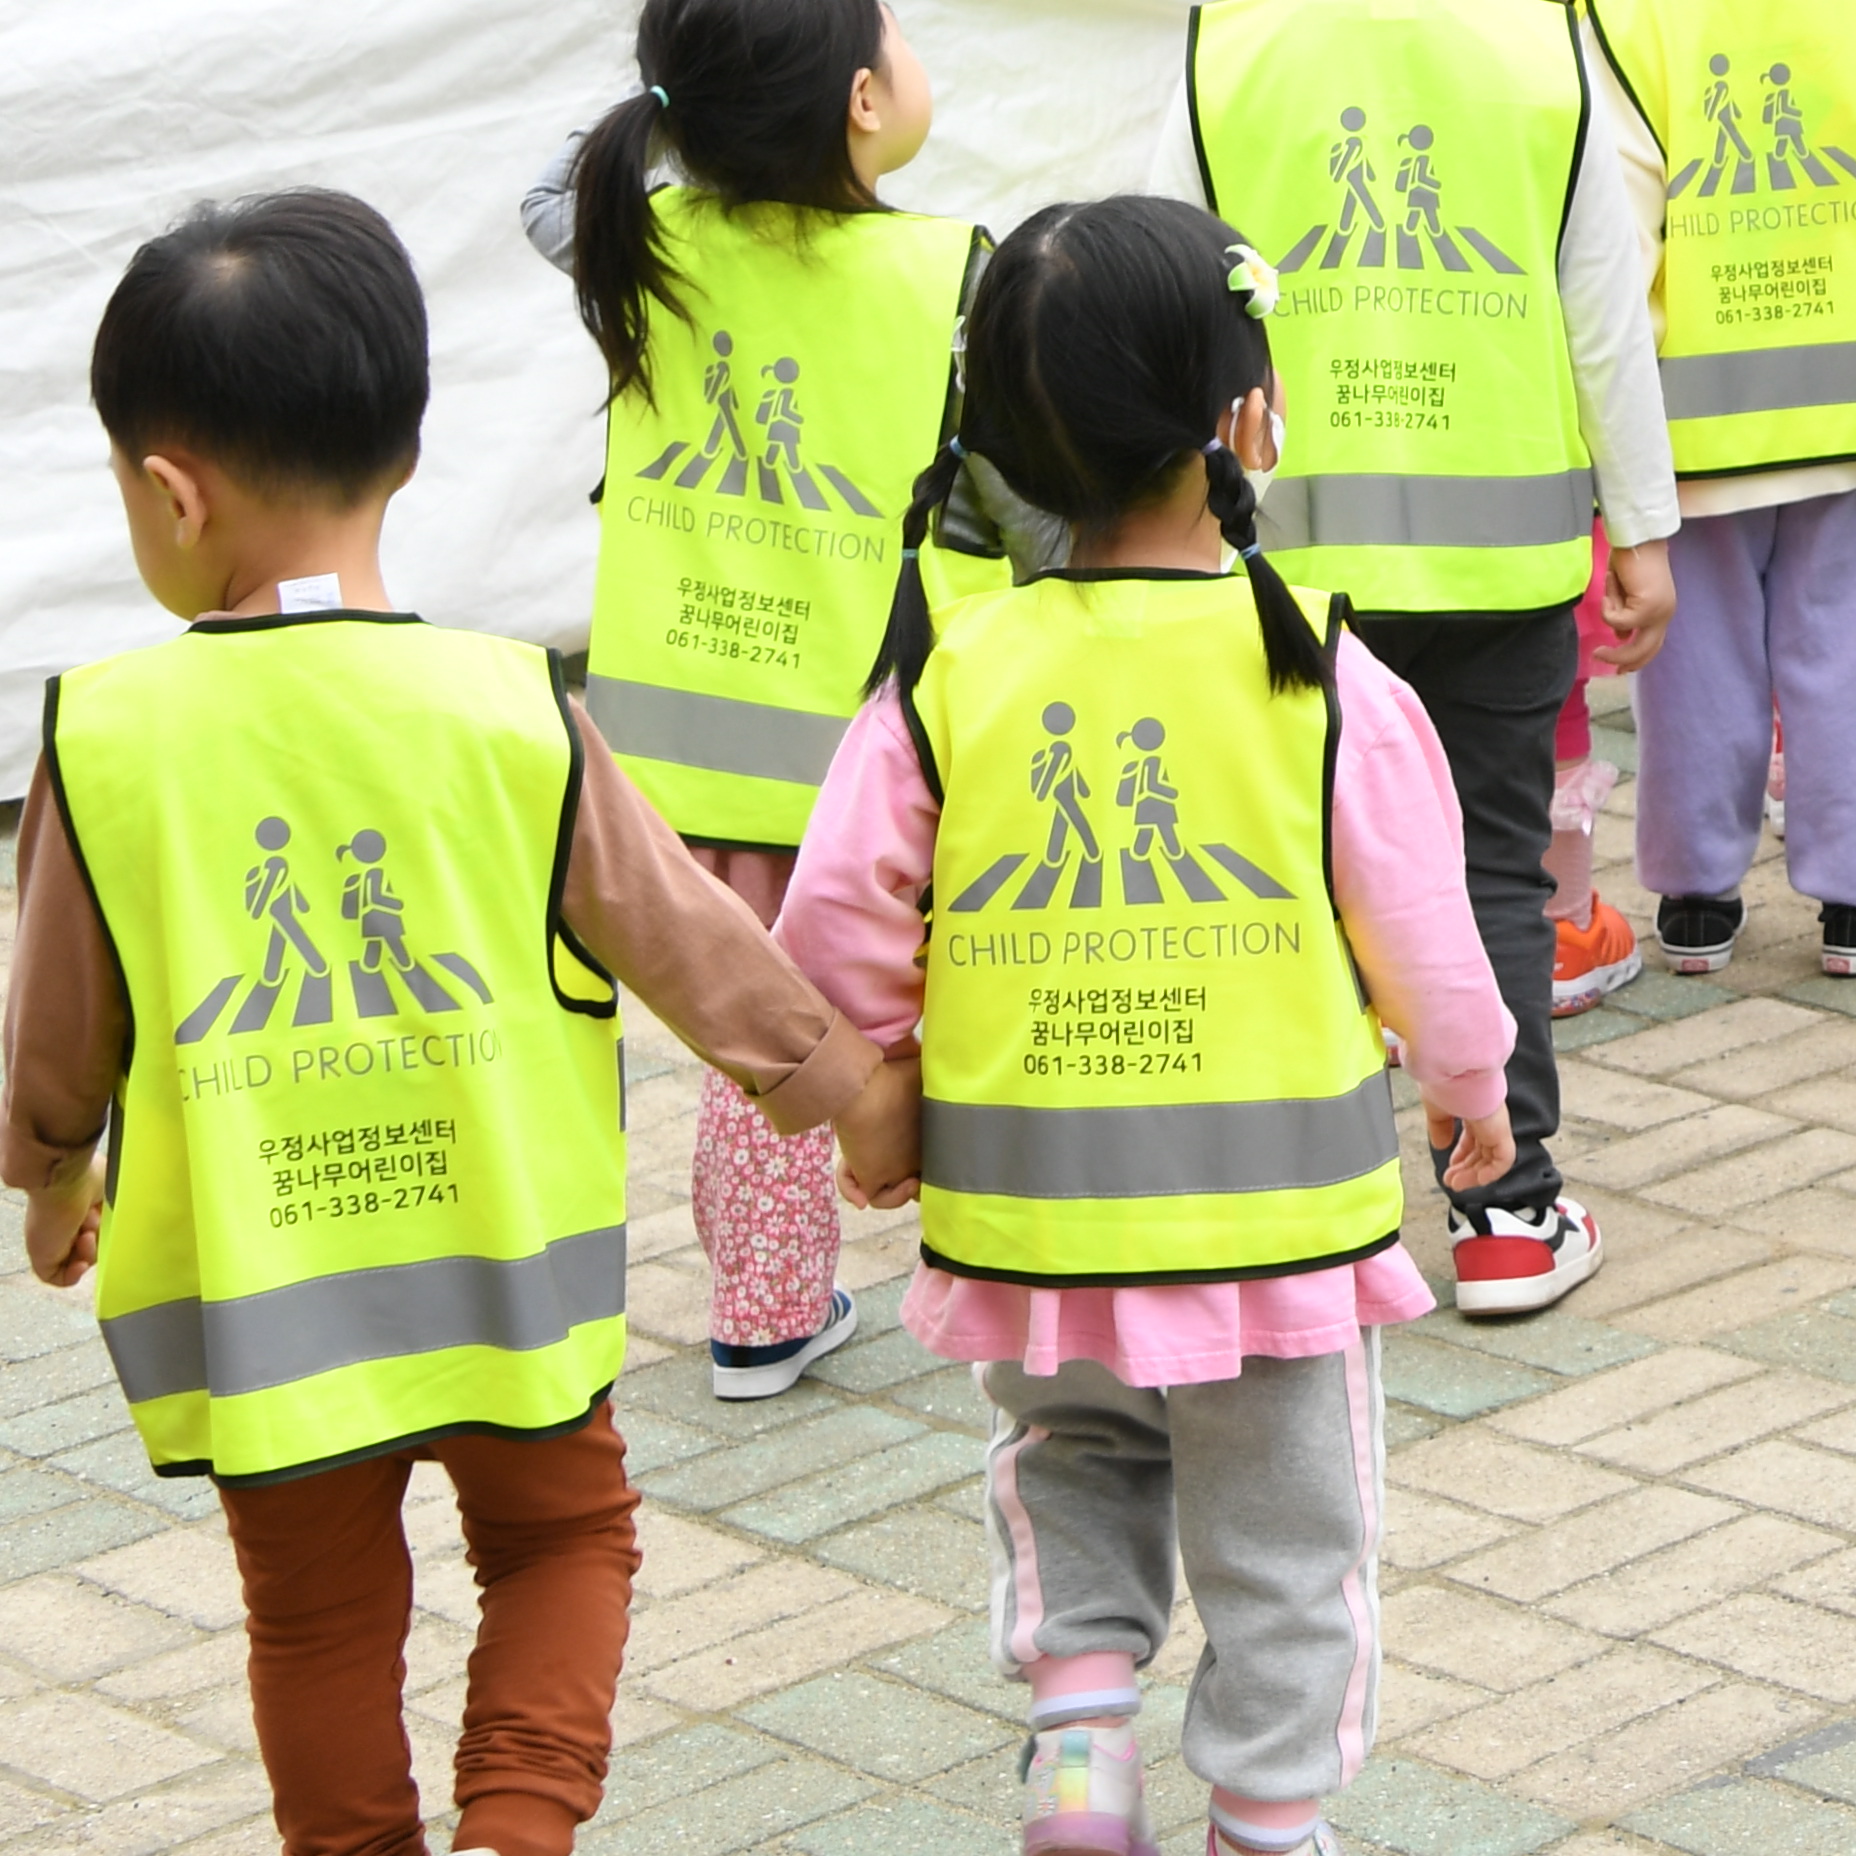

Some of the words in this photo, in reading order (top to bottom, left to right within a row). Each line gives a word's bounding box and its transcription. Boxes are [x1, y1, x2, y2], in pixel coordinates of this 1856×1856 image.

[1670, 212, 1720, 238] HILD
[1711, 255, 1833, 283] 우정사업정보센터
[1354, 285, 1528, 320] PROTECTION
[1718, 277, 1827, 304] 꿈나무어린이집
[1716, 300, 1834, 325] 061-338-2741
[1330, 358, 1456, 383] 우정사업정보센터
[1336, 384, 1445, 407] 꿈나무어린이집
[1330, 411, 1450, 431] 061-338-2741
[627, 495, 695, 533] CHILD
[706, 511, 885, 563] PROTECTION
[677, 577, 811, 622] 우정사업정보센터
[679, 603, 799, 645] 꿈나무어린이집
[666, 628, 801, 669] 061-338-2741
[948, 932, 1050, 966] CHILD
[1062, 922, 1300, 966] PROTECTION
[1028, 987, 1206, 1014] 우정사업정보센터
[1030, 1019, 1194, 1047] 꿈나무어린이집
[178, 1054, 272, 1101] HILD
[1023, 1053, 1203, 1076] 061-338-2741
[258, 1118, 457, 1164] 우정사업정보센터
[272, 1150, 448, 1197] 꿈나무어린이집
[269, 1183, 460, 1229] 061-338-2741
